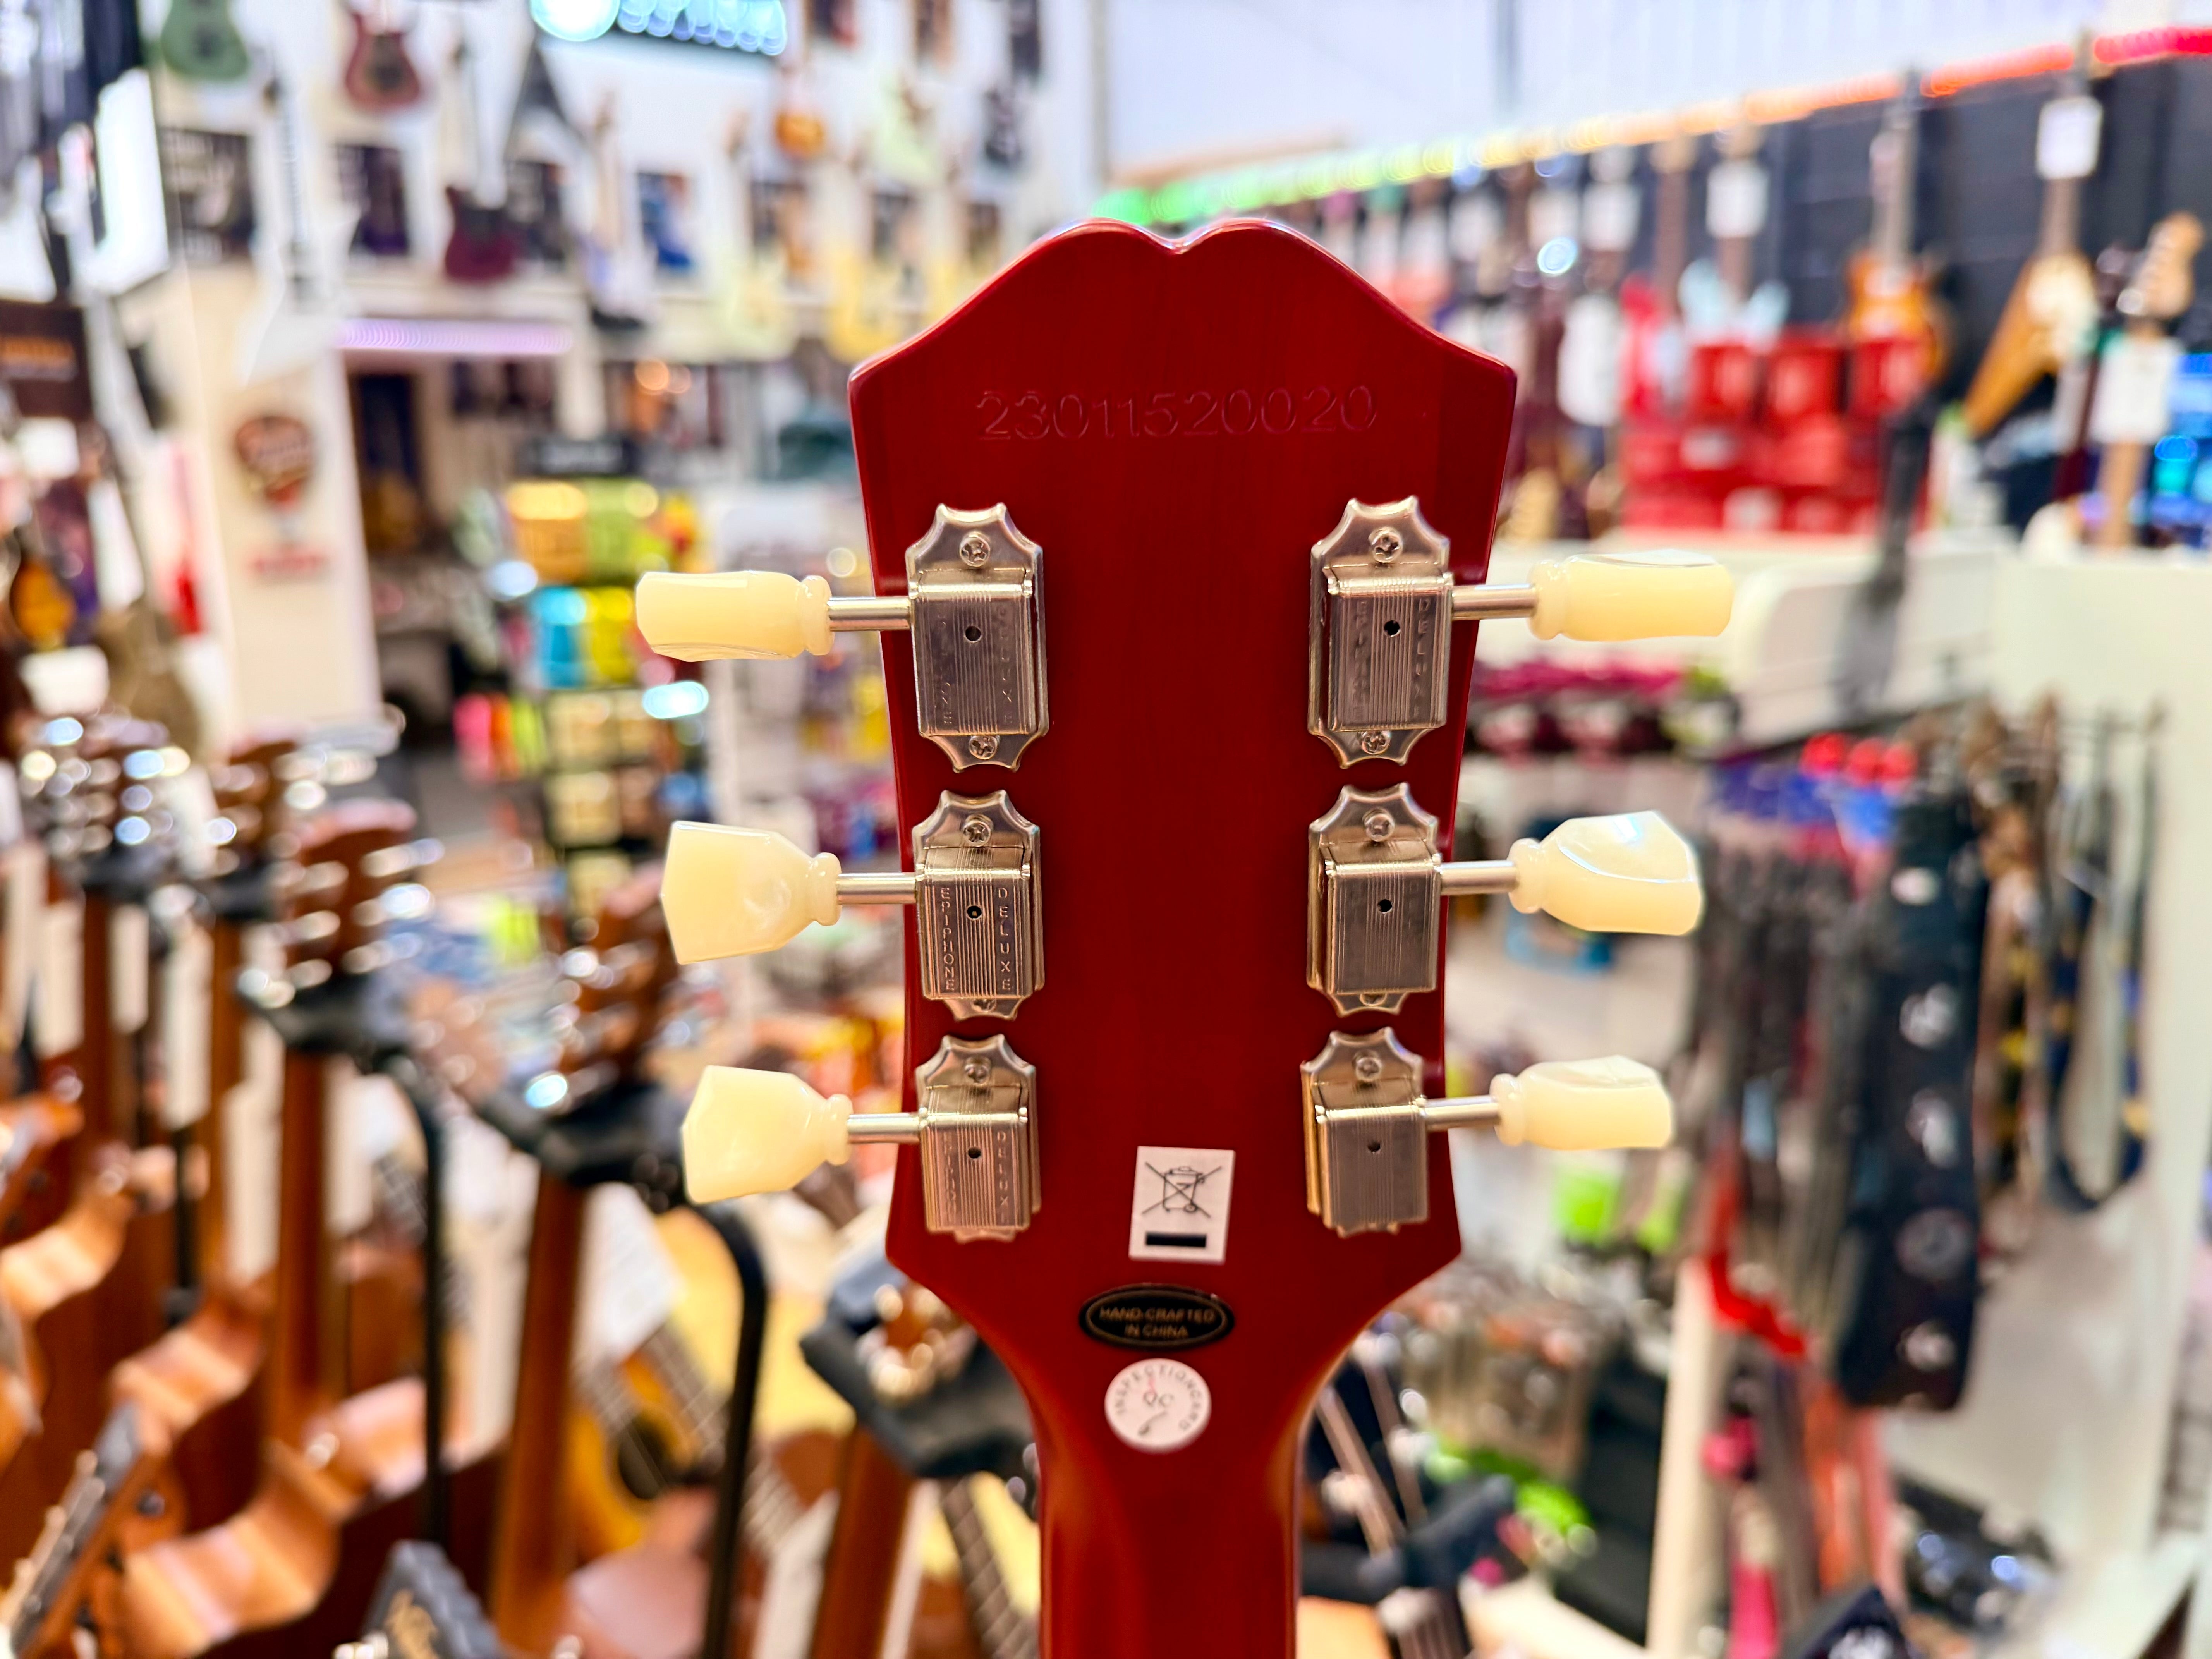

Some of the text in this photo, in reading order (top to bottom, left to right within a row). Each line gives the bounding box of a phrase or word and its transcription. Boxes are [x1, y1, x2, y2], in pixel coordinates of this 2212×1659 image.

[976, 385, 1377, 440] 23011520020
[941, 887, 955, 991] EPIPHONE
[998, 887, 1011, 990] DELUXE
